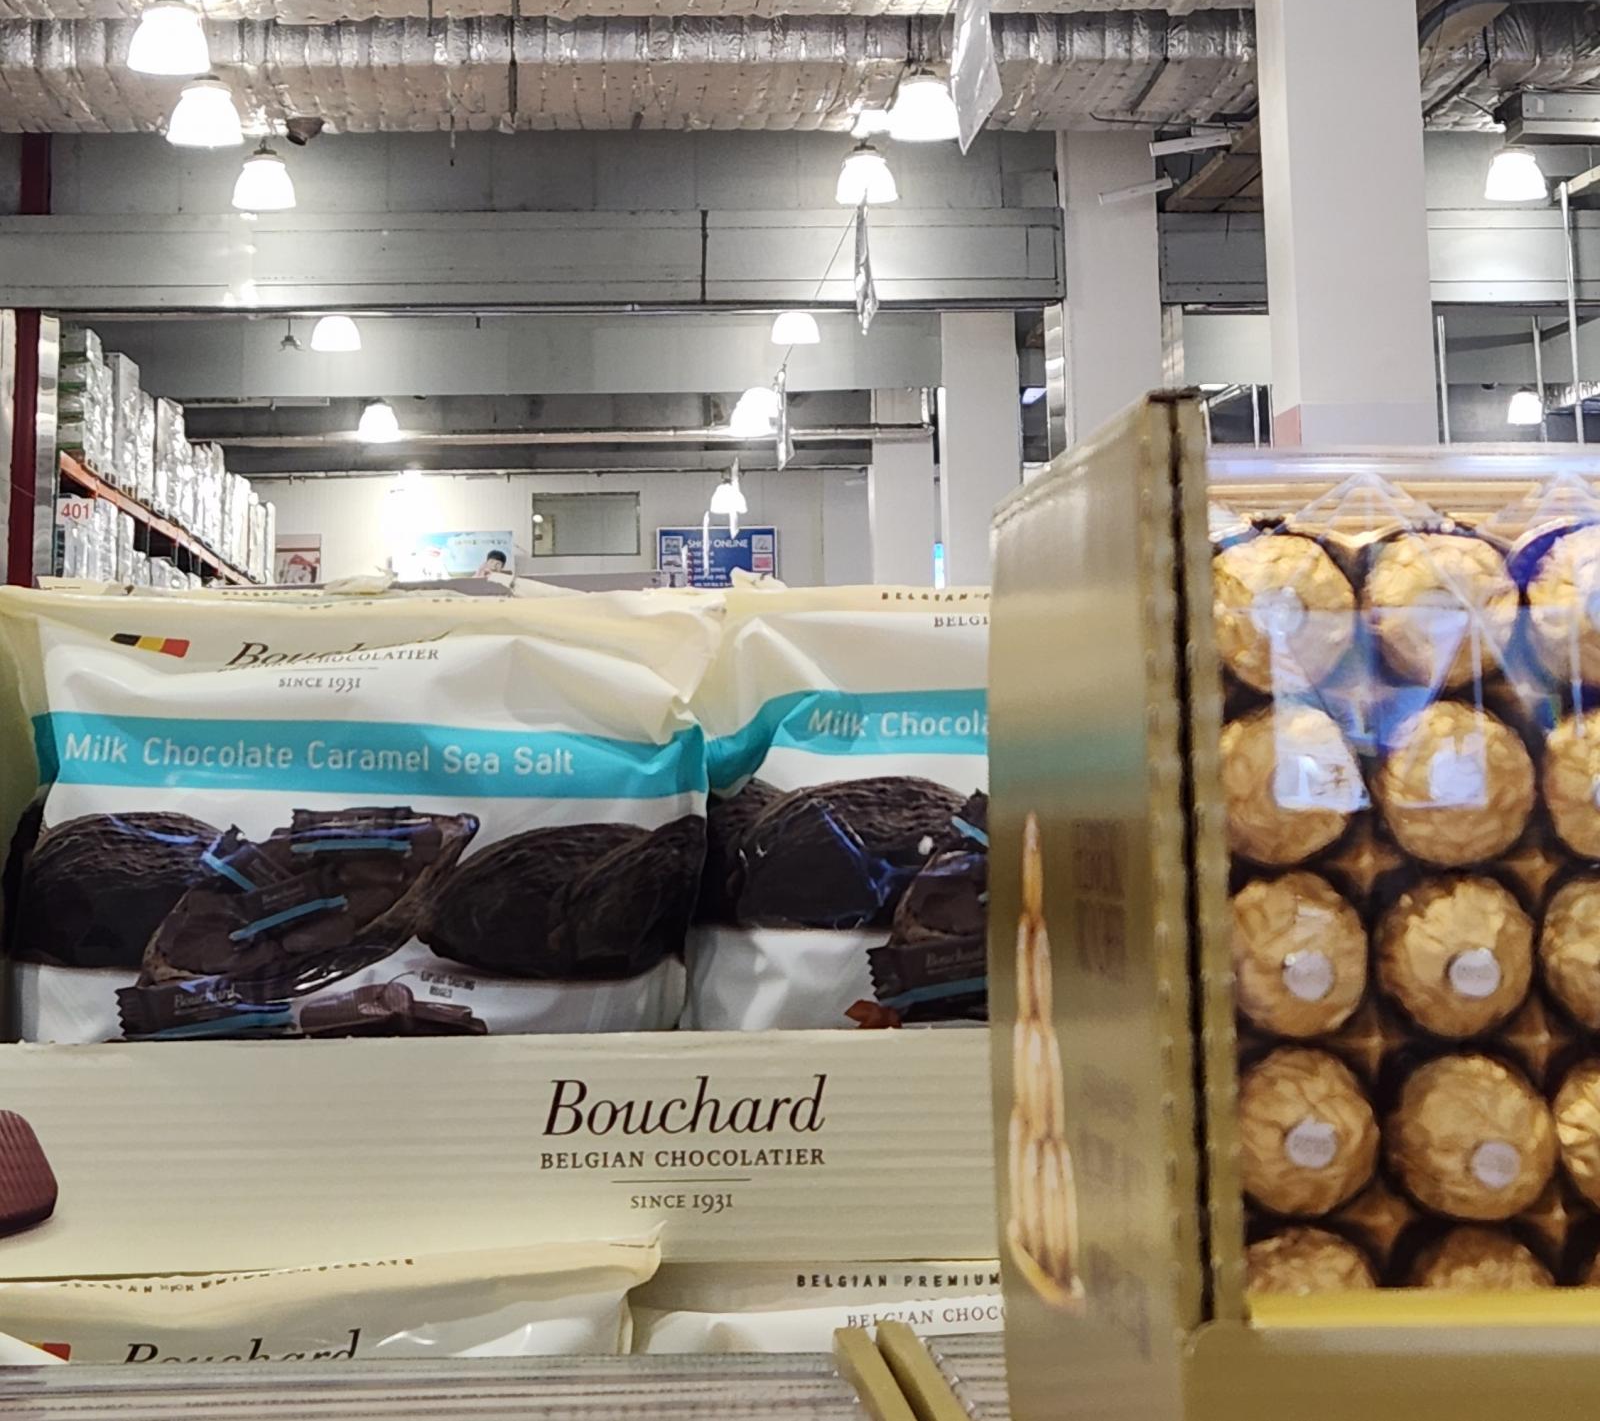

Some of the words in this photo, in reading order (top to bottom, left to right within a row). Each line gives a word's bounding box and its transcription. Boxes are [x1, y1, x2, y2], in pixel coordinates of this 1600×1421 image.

[61, 503, 90, 519] 401
[687, 539, 713, 549] SH
[713, 538, 748, 549] ONLINE
[278, 676, 323, 689] SINCE
[328, 676, 362, 693] 1931
[808, 708, 869, 738] Milk
[64, 733, 128, 764] Milk
[142, 736, 294, 769] Chocolate
[306, 741, 430, 772] Caramel
[442, 745, 500, 776] Sea
[513, 746, 575, 776] Salt
[542, 1073, 828, 1136] Bouchard
[540, 1150, 645, 1171] BELGIAN
[654, 1148, 826, 1168] CHOCOLATIER
[630, 1194, 686, 1210] SINCE
[692, 1193, 734, 1214] 1931
[796, 1274, 888, 1288] BELGIAN
